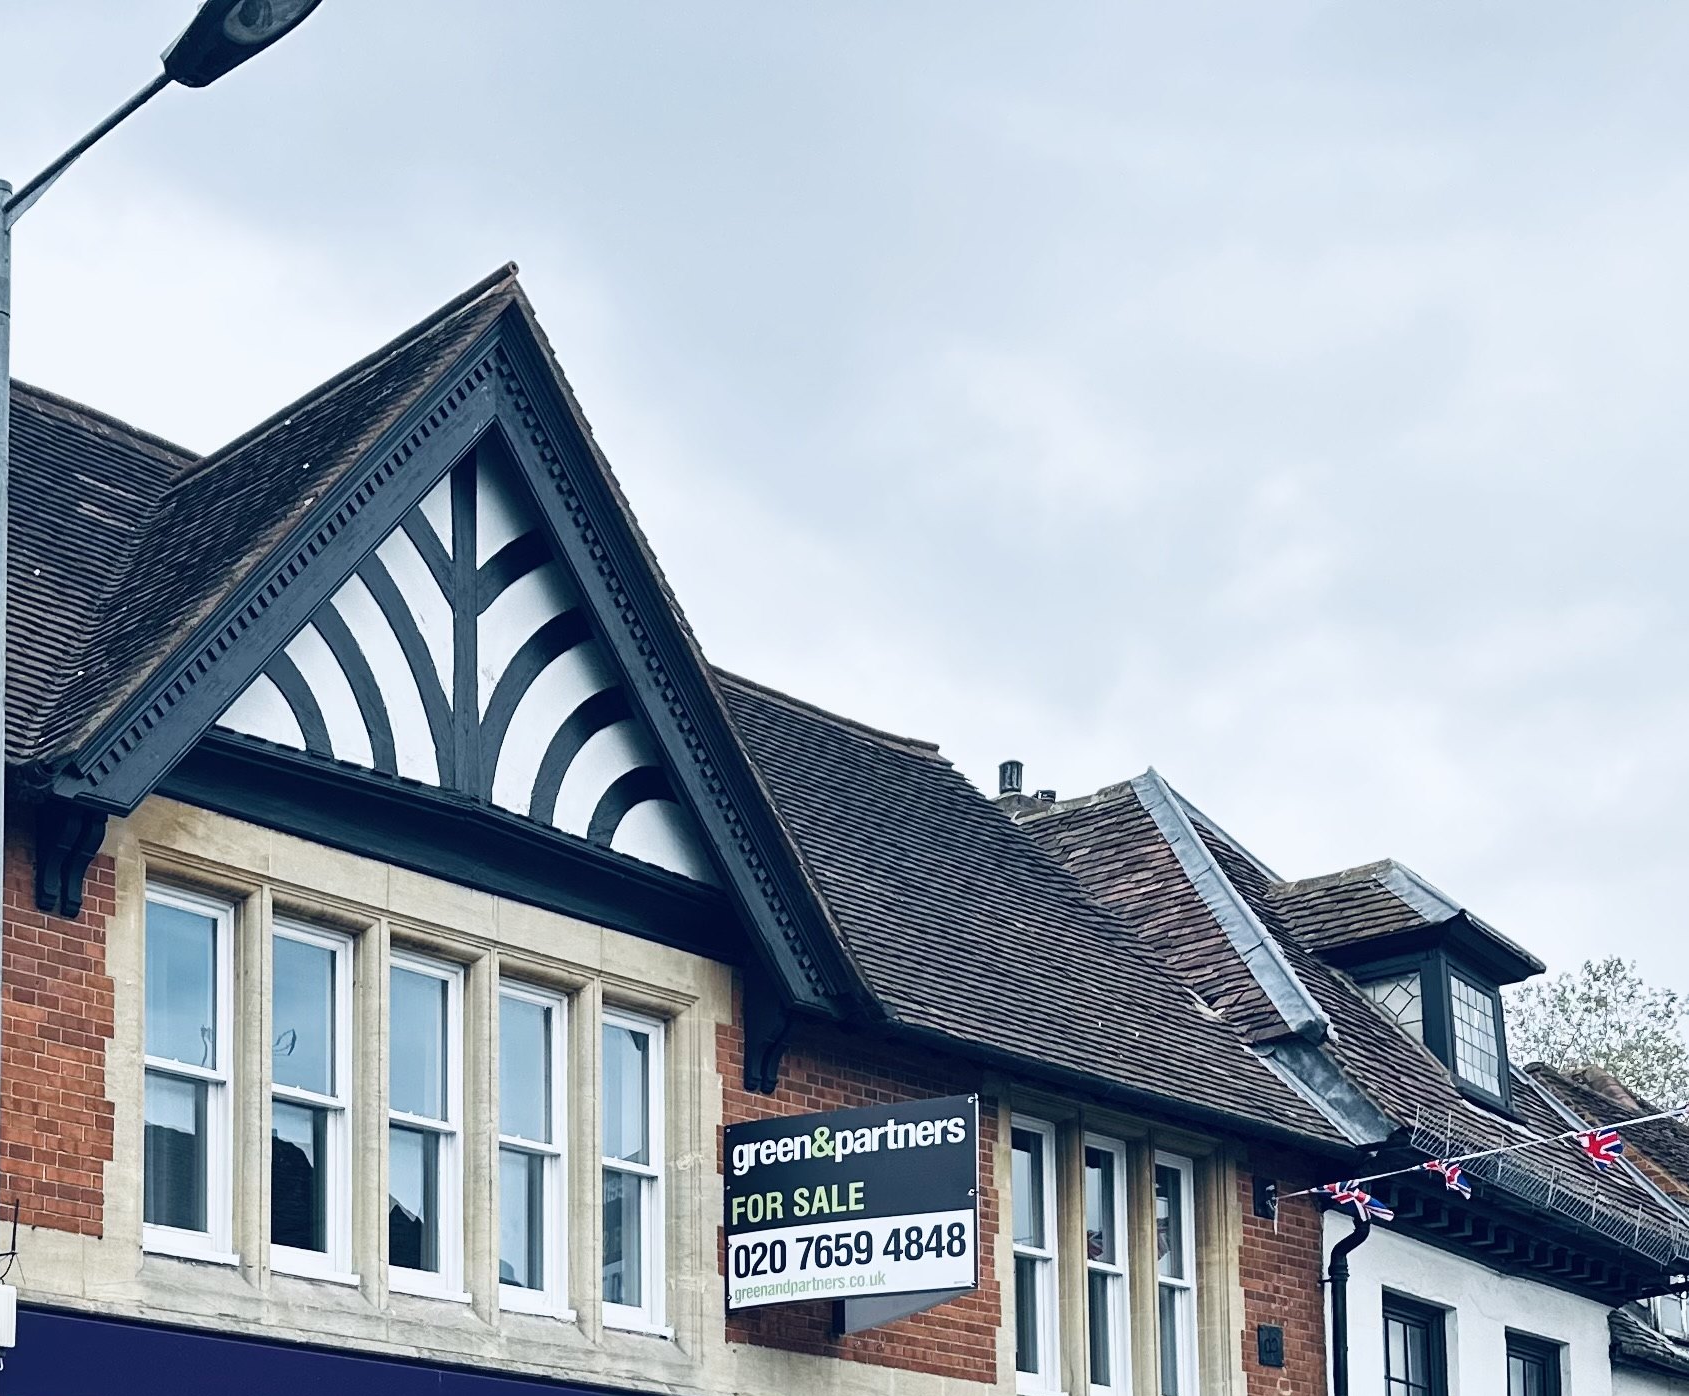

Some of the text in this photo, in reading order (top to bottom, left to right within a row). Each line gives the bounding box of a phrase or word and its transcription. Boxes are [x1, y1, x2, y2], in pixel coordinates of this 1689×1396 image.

[732, 1116, 966, 1176] green&partners
[731, 1181, 865, 1226] FOR SALE
[734, 1222, 967, 1279] 020 7659 4848
[734, 1270, 886, 1304] greenandpartners.co.uk
